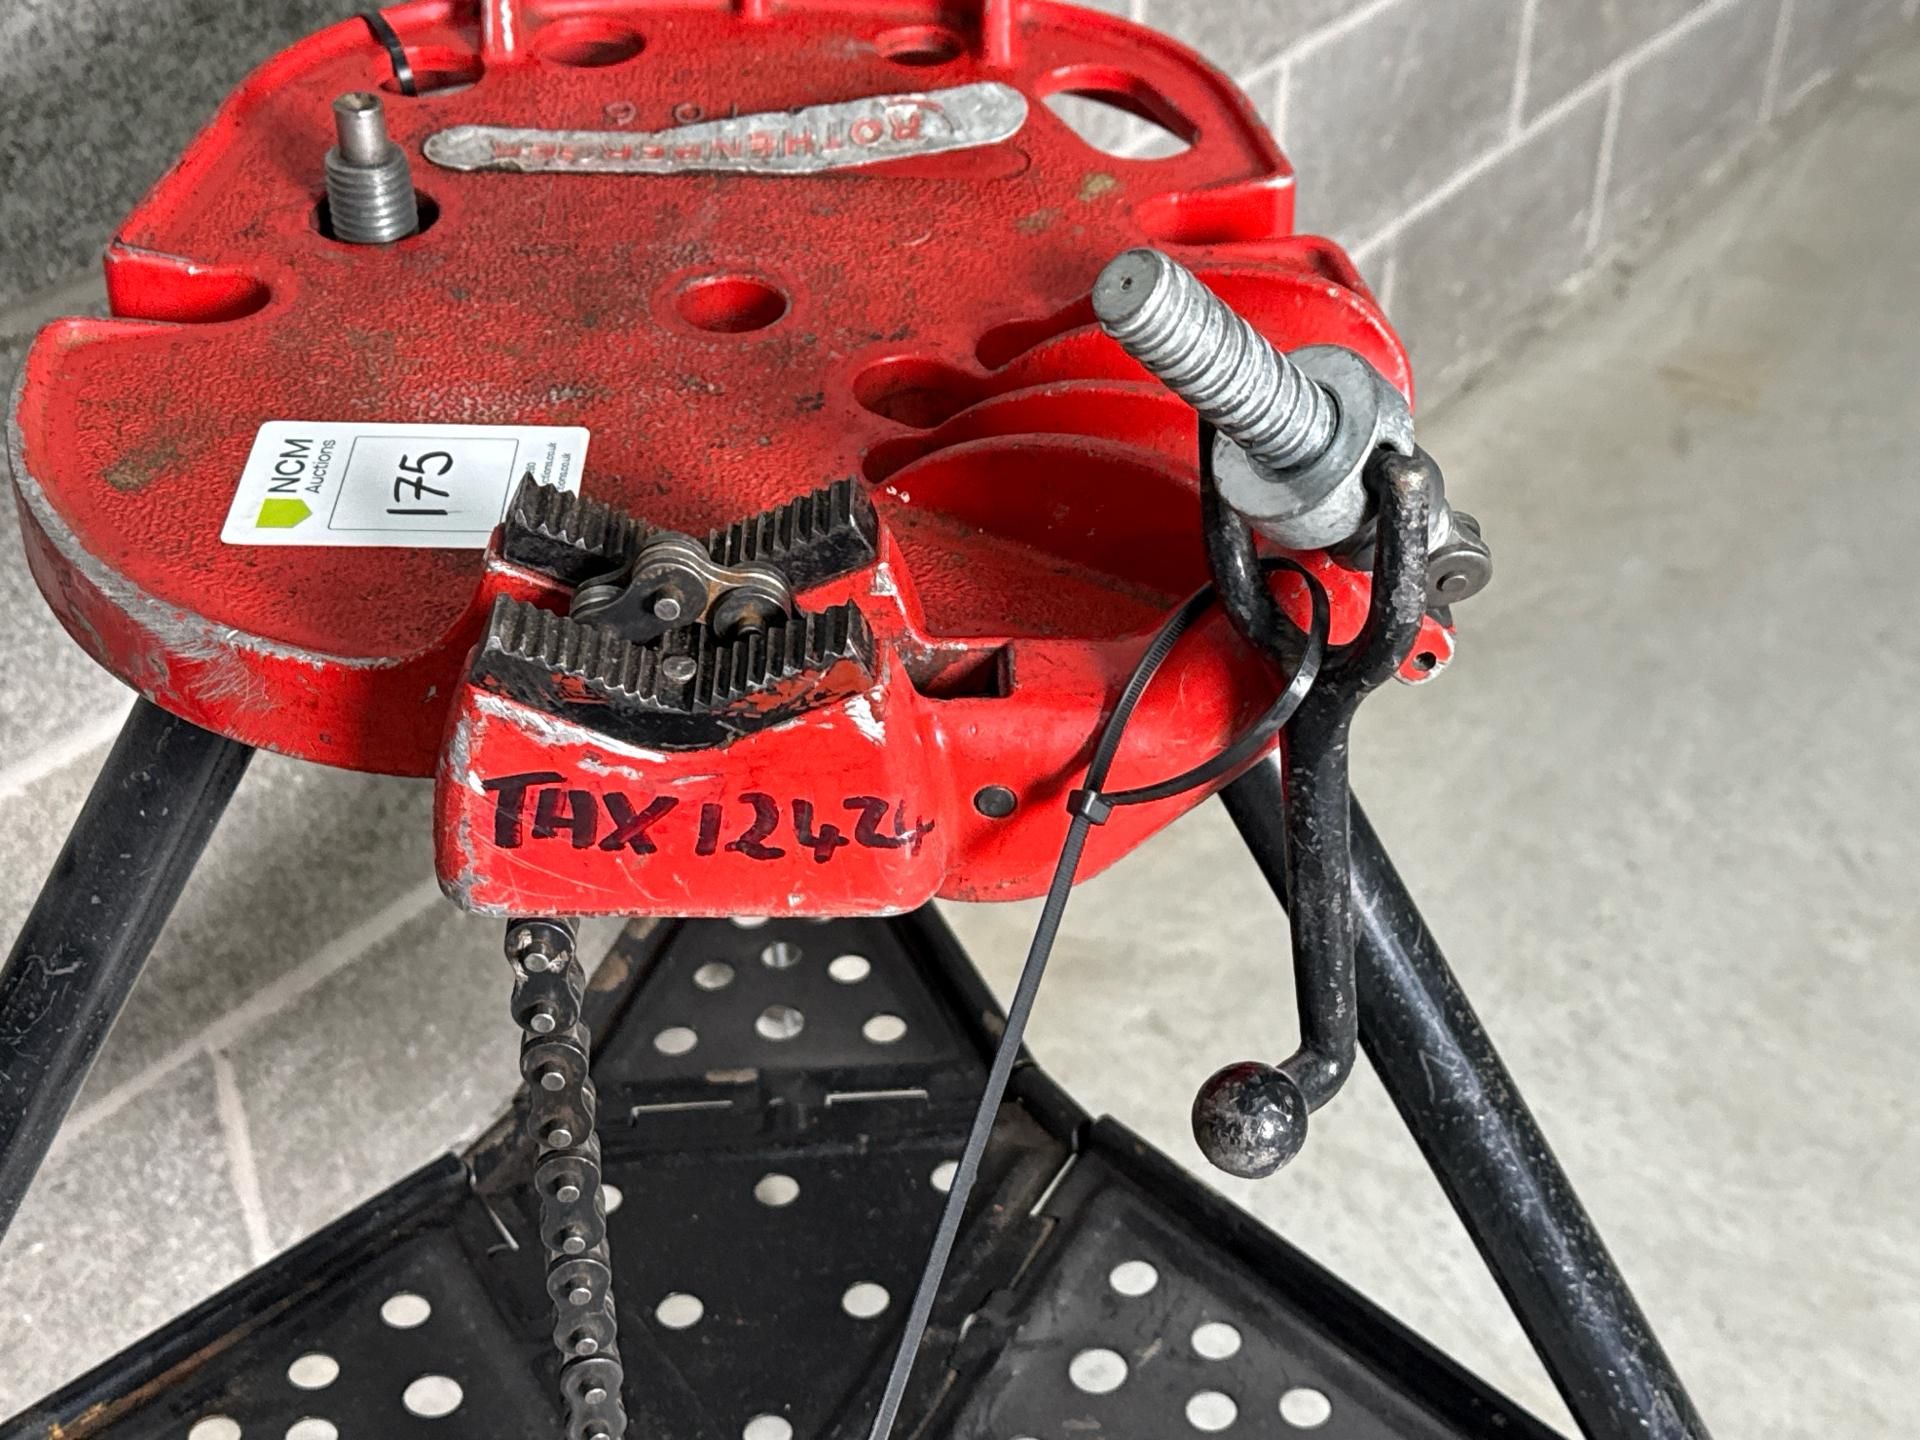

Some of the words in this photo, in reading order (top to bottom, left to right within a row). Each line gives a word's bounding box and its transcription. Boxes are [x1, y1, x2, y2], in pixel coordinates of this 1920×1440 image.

[267, 438, 314, 493] NCM
[304, 439, 337, 494] Auctions
[385, 450, 454, 516] 175
[541, 442, 557, 484] ctions.co.uk
[482, 771, 679, 855] TAX
[694, 791, 936, 864] 12424
